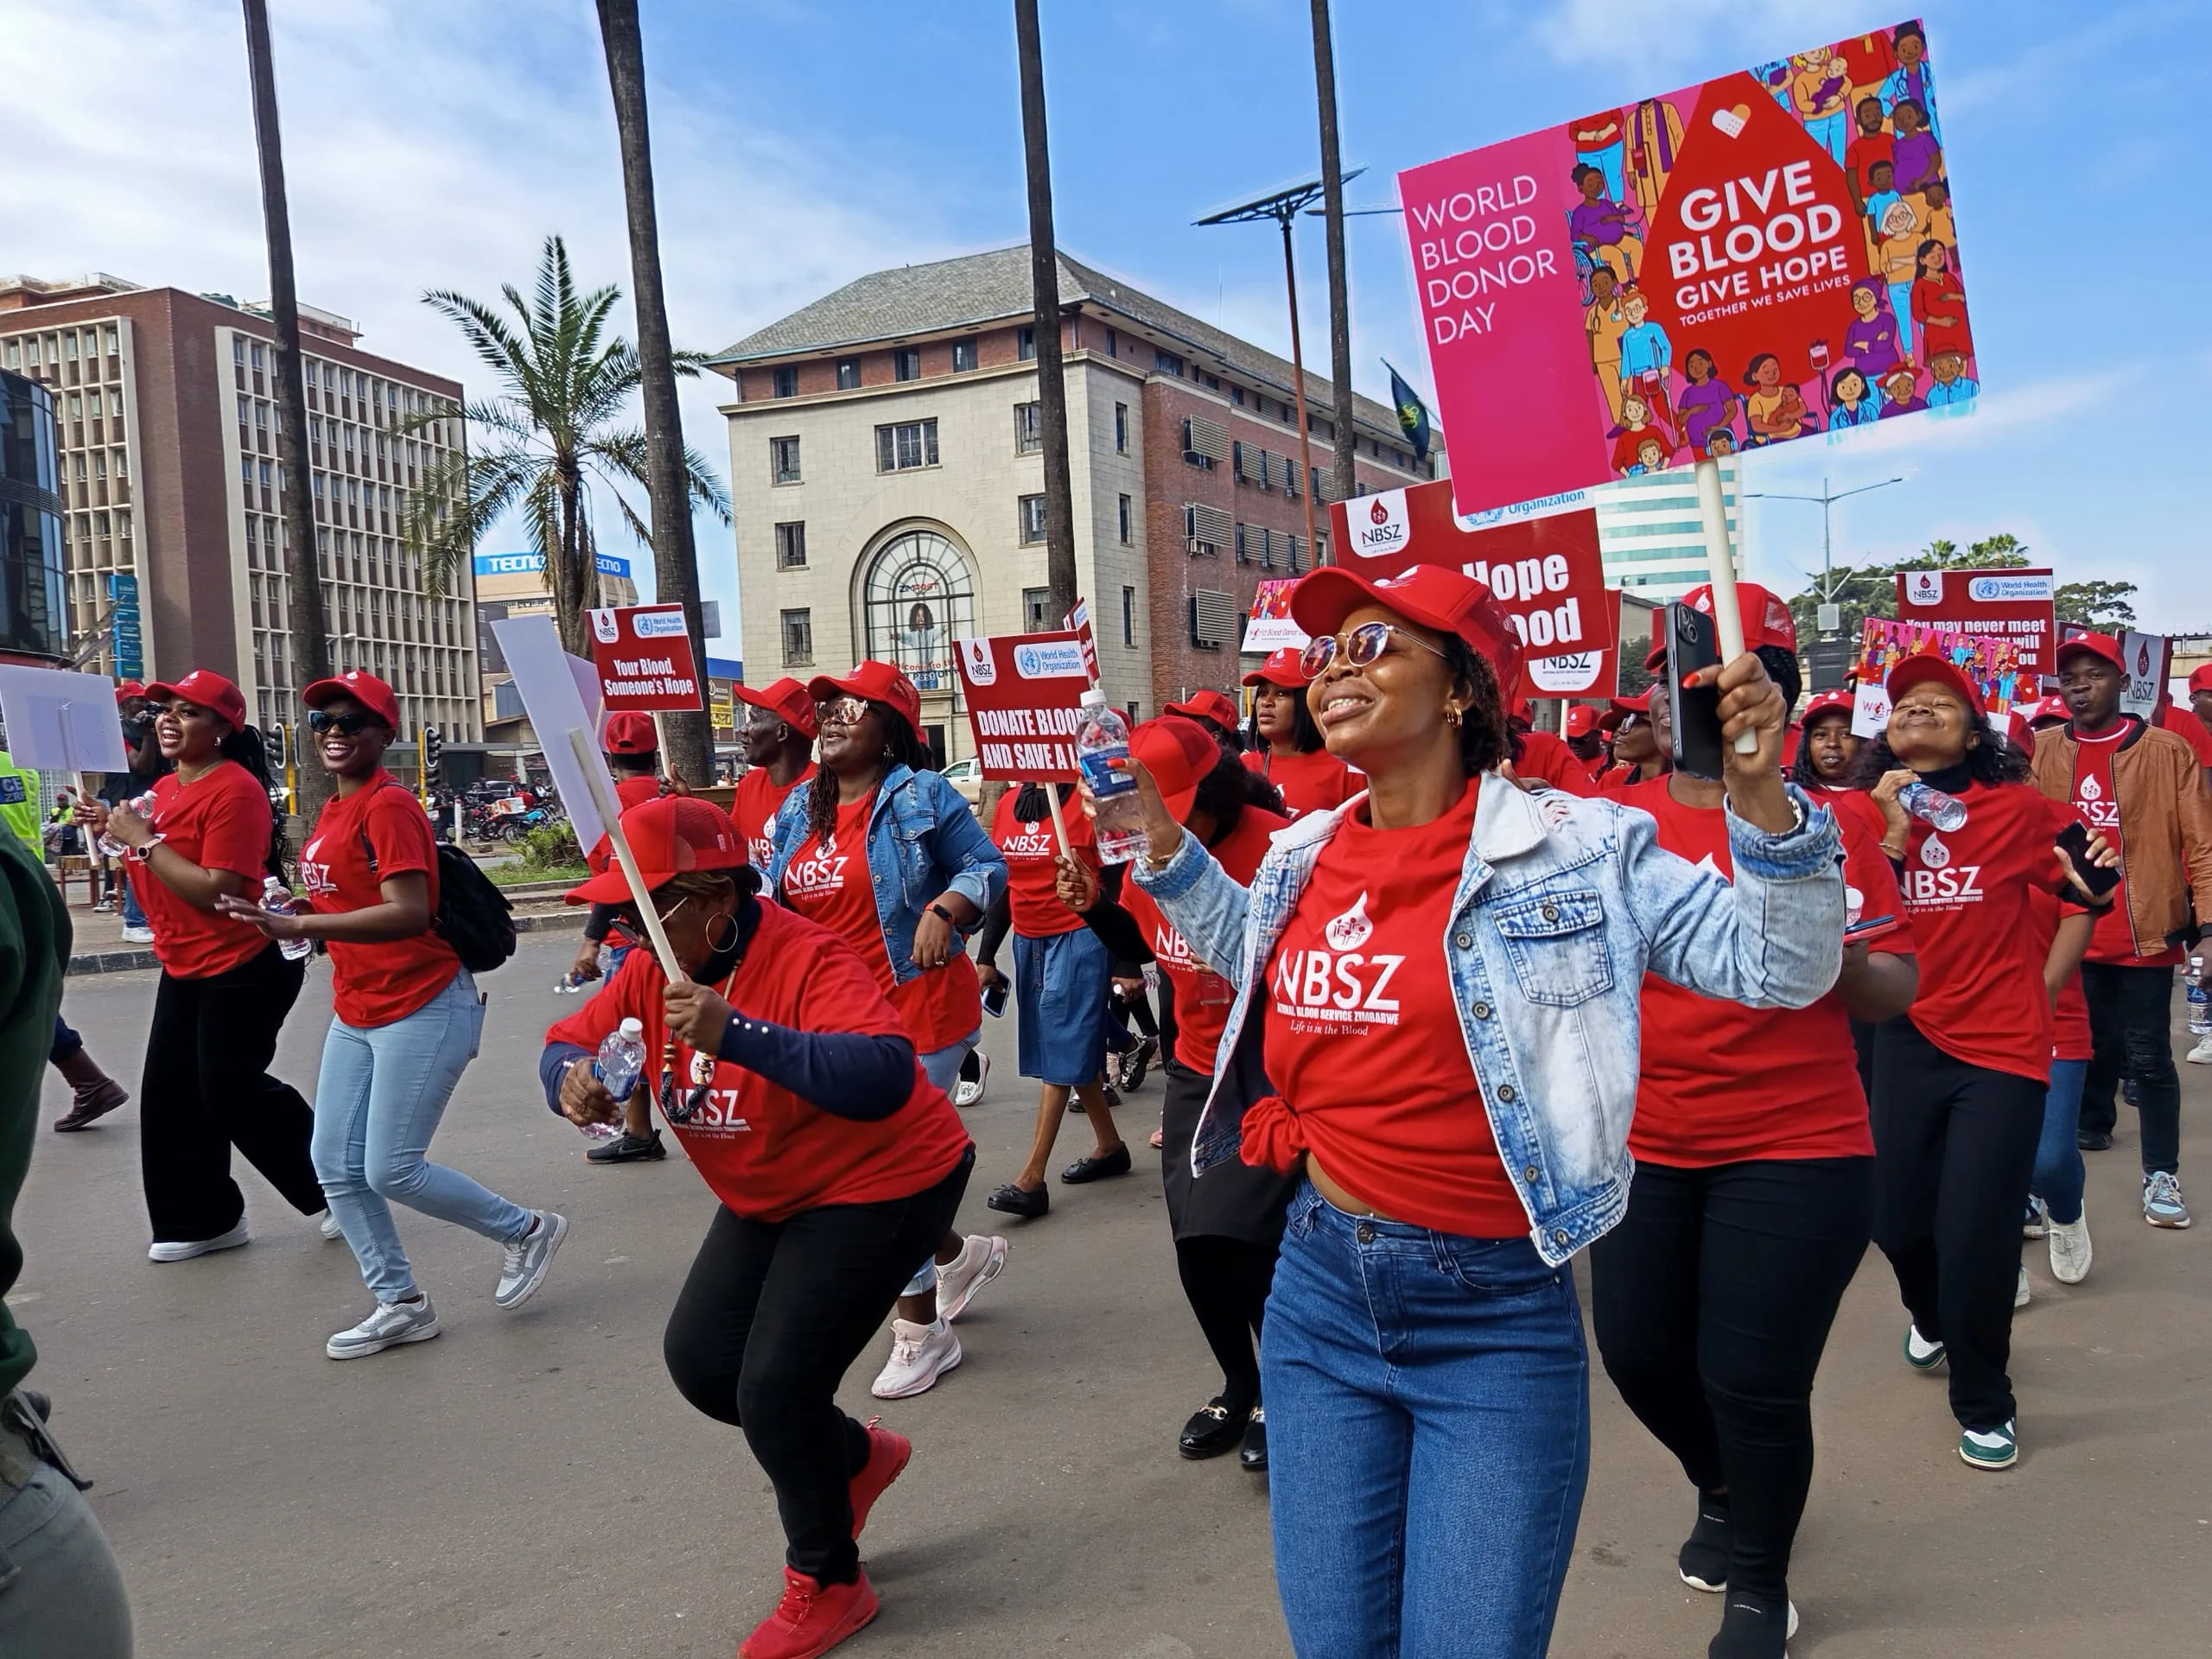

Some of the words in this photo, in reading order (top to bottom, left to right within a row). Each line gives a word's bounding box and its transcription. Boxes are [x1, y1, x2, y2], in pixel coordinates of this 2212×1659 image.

[1412, 175, 1537, 232] WORLD
[1680, 160, 1815, 232] GIVE
[1421, 215, 1535, 270] BLOOD
[1669, 204, 1842, 280] BLOOD
[1427, 249, 1558, 308] DONOR
[1675, 270, 1751, 309] GIVE
[1759, 245, 1848, 289] HOPE
[1680, 301, 1748, 327] TOGETHER
[1751, 295, 1772, 308] WE
[1777, 284, 1810, 302] SAVE
[1813, 274, 1851, 293] LIVES
[1434, 302, 1496, 345] DAY
[1508, 490, 1585, 515] Organization
[1362, 524, 1402, 545] NBSZ
[596, 561, 621, 573] ECNO
[1914, 590, 1938, 599] NBSZ
[1964, 620, 2005, 632] never
[2007, 619, 2046, 632] meet
[1040, 649, 1058, 660] World
[1058, 647, 1078, 659] Health
[2018, 653, 2037, 665] ou
[613, 659, 639, 677] Your
[639, 658, 676, 677] Blood,
[971, 663, 993, 677] NBSZ
[1042, 661, 1081, 673] Organization
[605, 677, 664, 696] Someone's
[664, 677, 694, 696] Hope
[2126, 679, 2154, 701] NBSZ
[976, 709, 1036, 736] DONATE
[982, 743, 1014, 769] AND
[1014, 743, 1055, 770] SAVE
[1054, 743, 1068, 770] A
[2071, 801, 2120, 822] BSZ
[748, 836, 775, 859] NB
[1002, 834, 1052, 852] NBSZ
[785, 856, 849, 890] NBSZ
[1156, 922, 1189, 957] NB
[1274, 947, 1407, 1011] NBSZ
[1296, 1006, 1319, 1019] BLOOD
[1319, 1008, 1353, 1022] SERVICE
[1354, 1011, 1399, 1026] ZIMBABWE
[1290, 1020, 1305, 1034] Life
[1306, 1021, 1313, 1033] is
[1313, 1023, 1322, 1034] in
[1324, 1024, 1338, 1035] the
[1342, 1025, 1369, 1036] Blood
